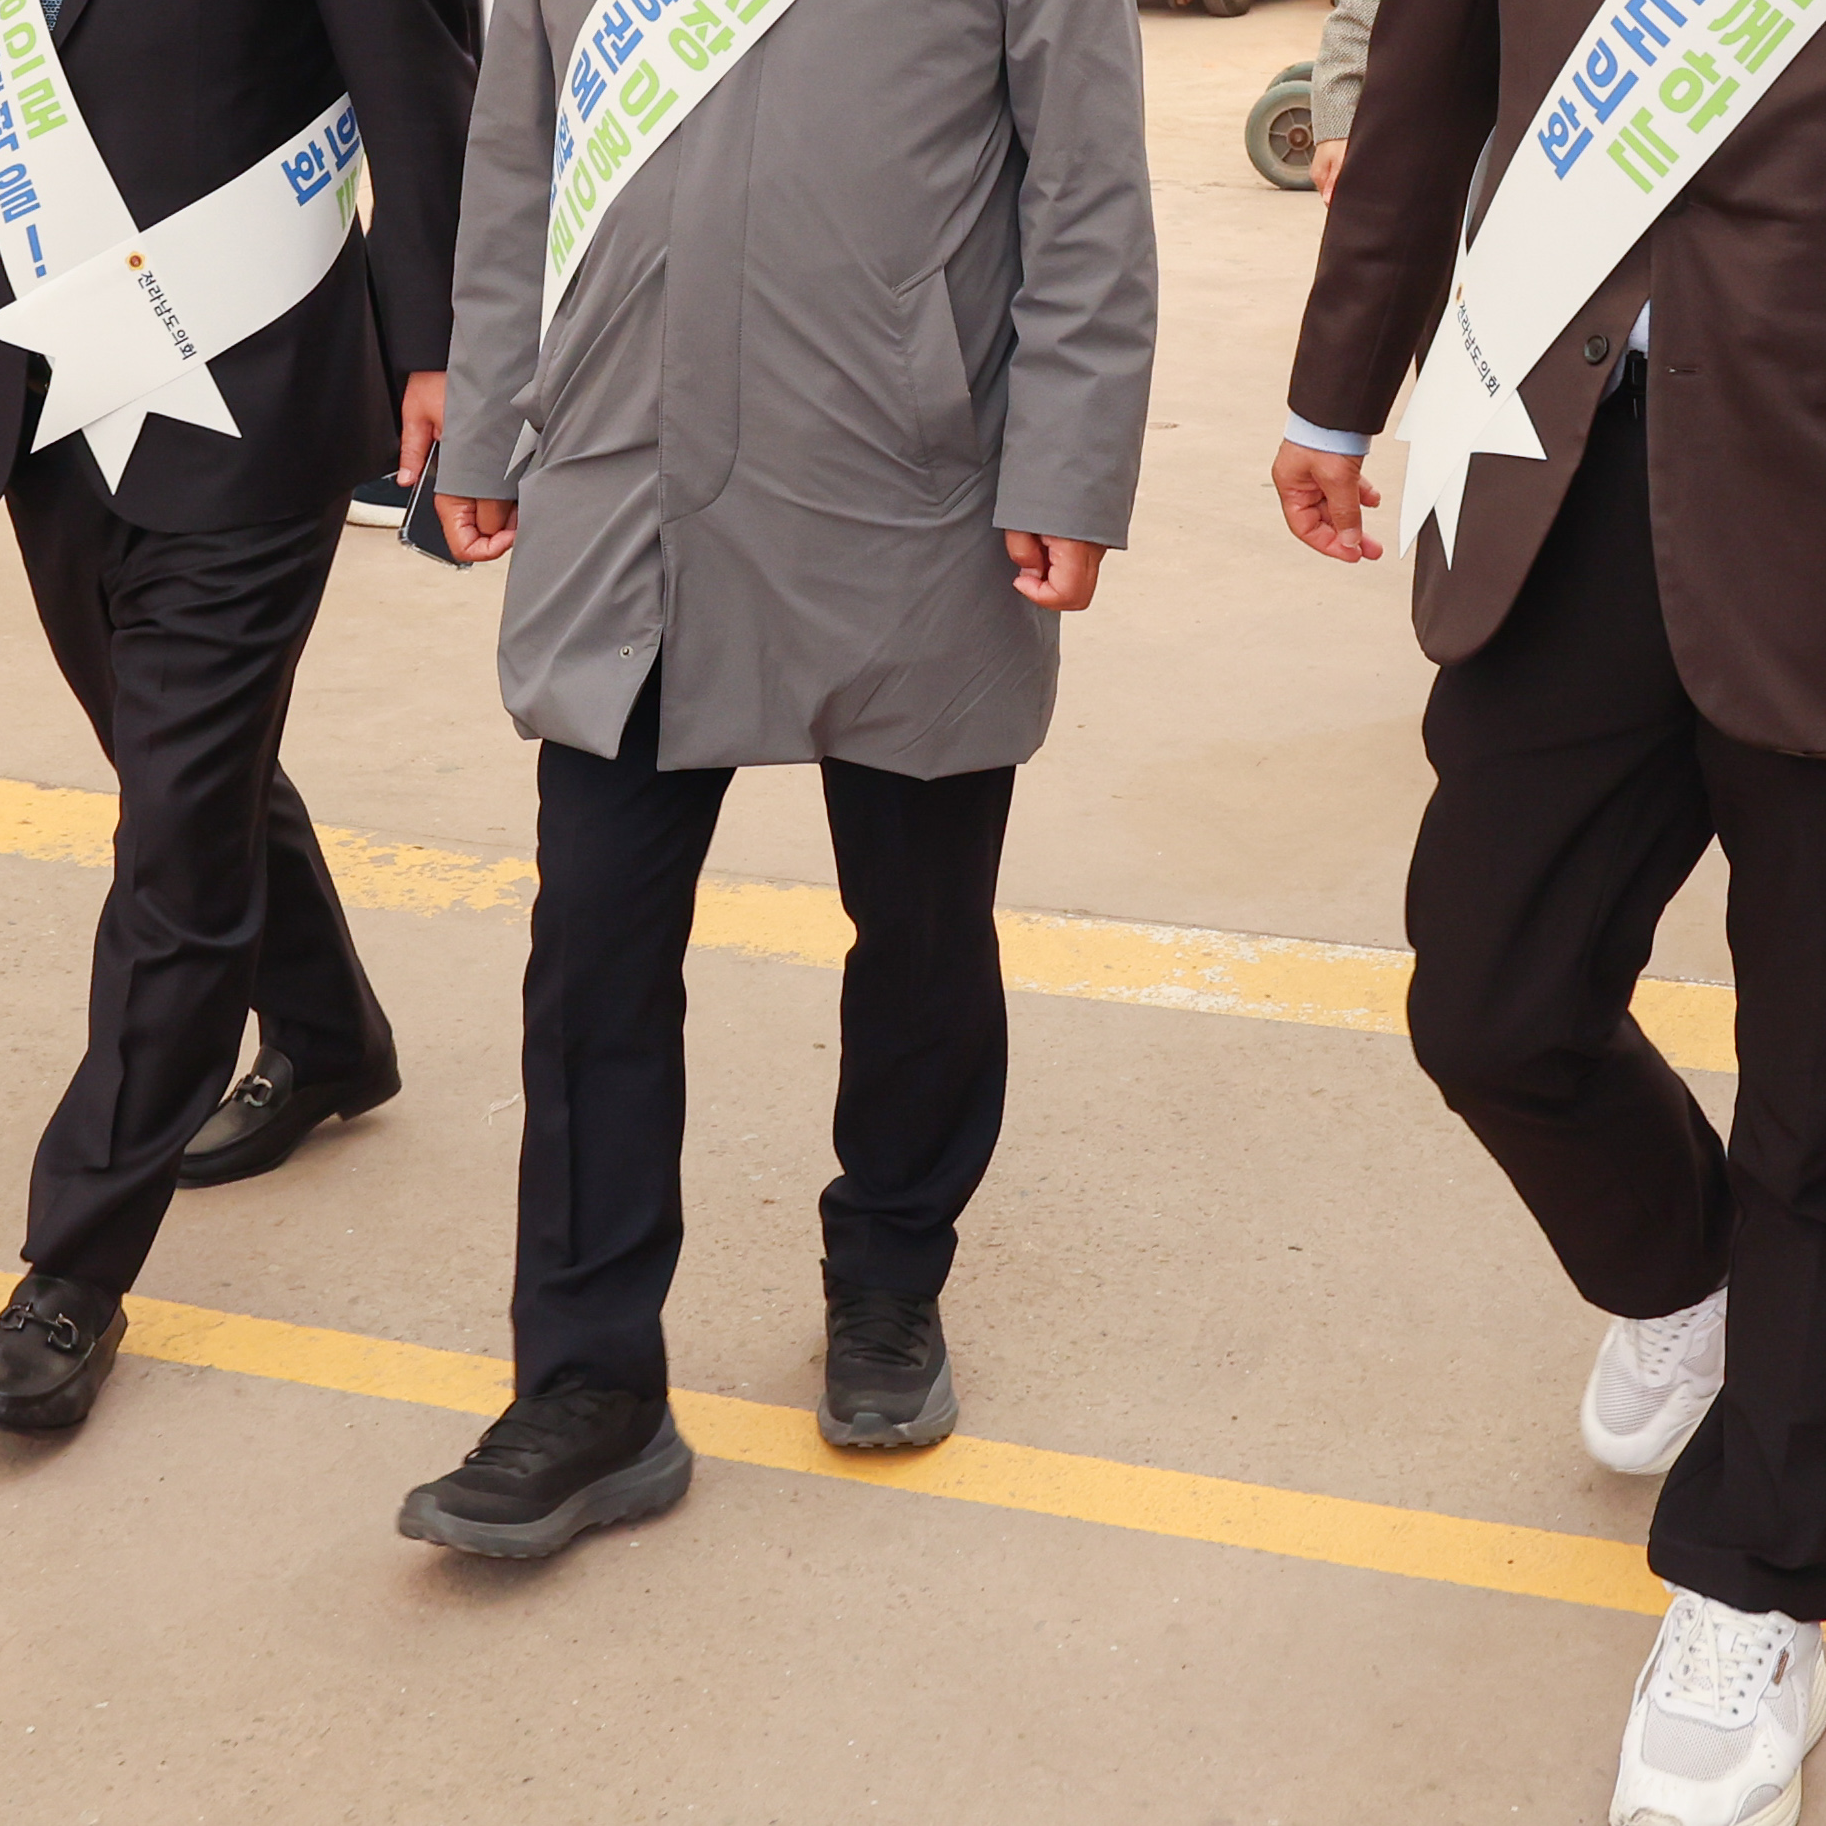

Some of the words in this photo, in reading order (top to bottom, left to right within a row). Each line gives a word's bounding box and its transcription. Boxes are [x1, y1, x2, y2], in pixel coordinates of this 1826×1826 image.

[549, 58, 680, 278] 이용으로
[137, 270, 198, 361] 전라남도의회
[1456, 299, 1501, 398] 전라남도의회
